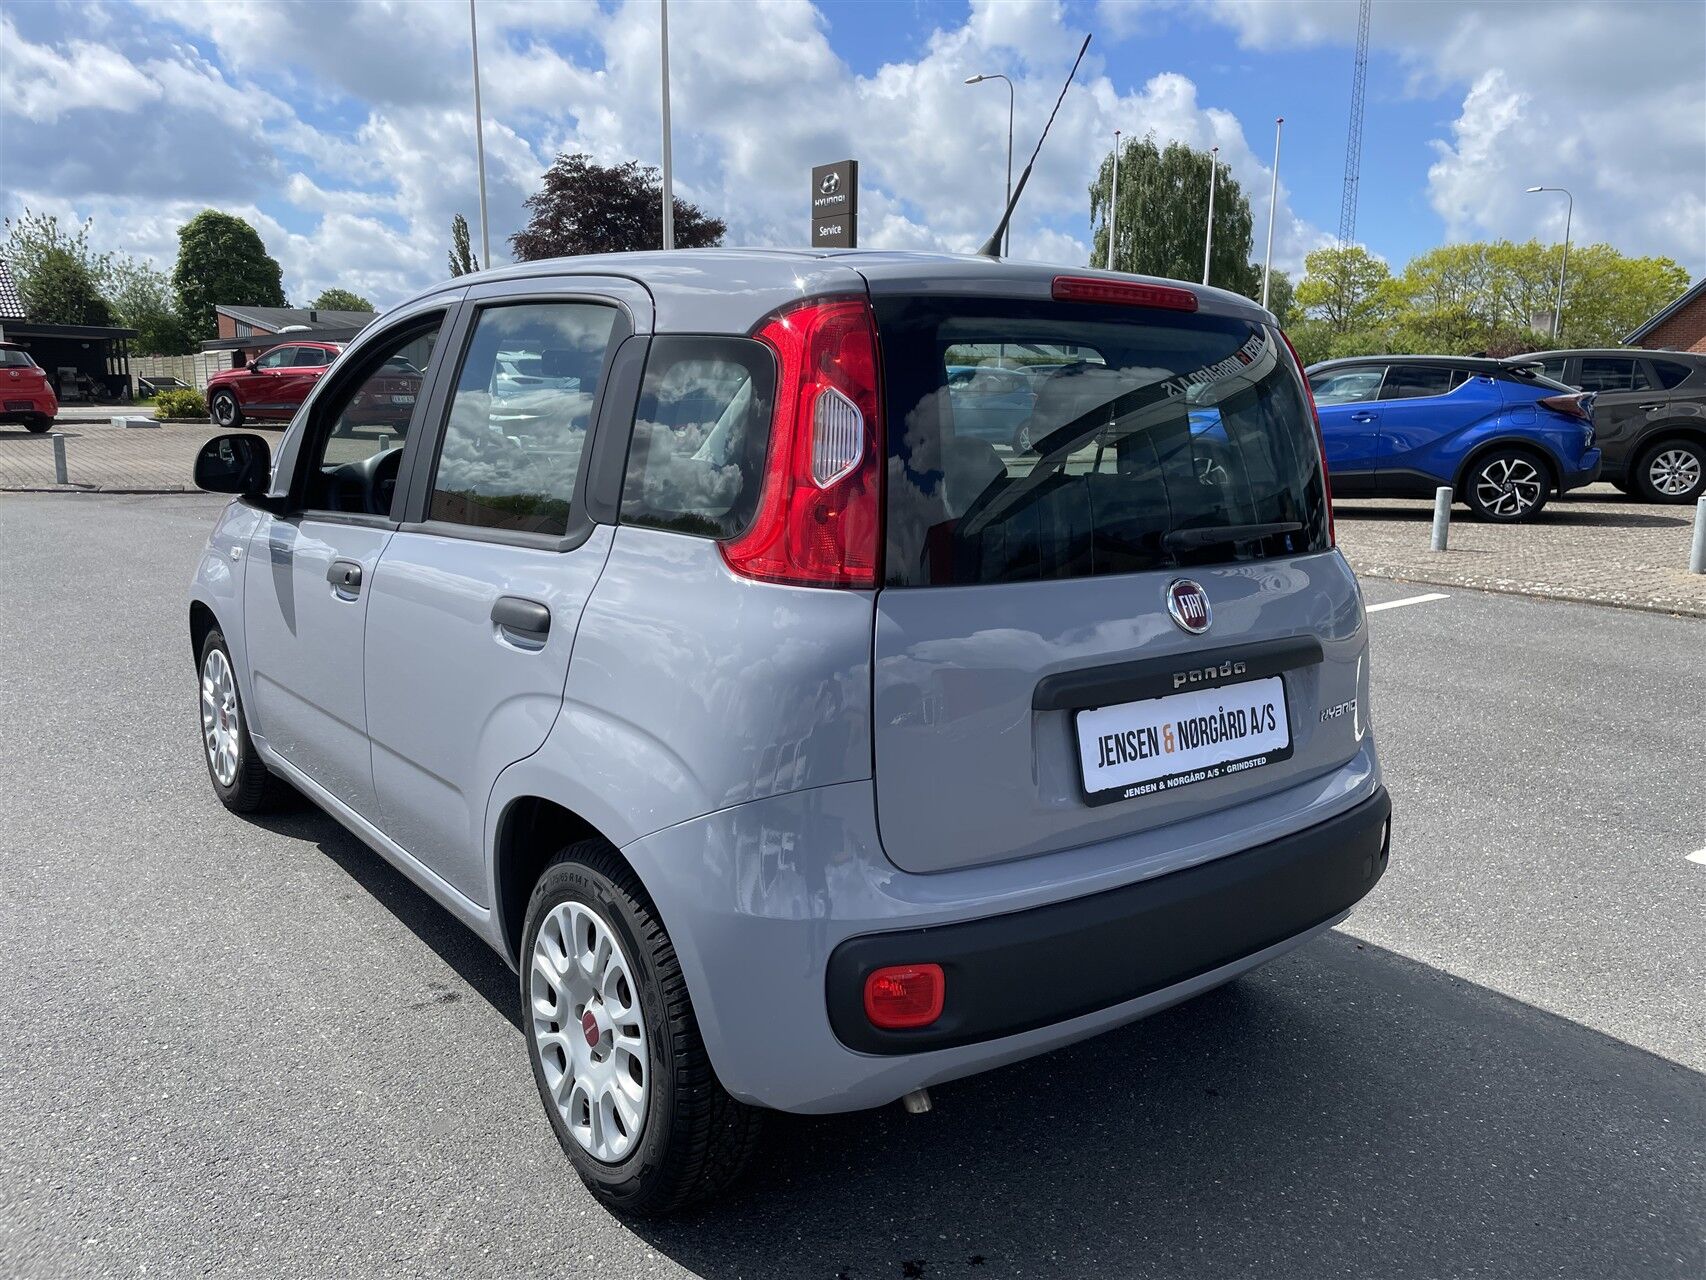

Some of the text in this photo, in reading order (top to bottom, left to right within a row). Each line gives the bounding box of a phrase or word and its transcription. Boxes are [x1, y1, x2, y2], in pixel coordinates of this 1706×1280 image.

[819, 224, 842, 237] Service
[1178, 593, 1205, 619] FIAT
[1173, 660, 1248, 689] panda
[1098, 702, 1277, 768] JENSEN & NØRGÅRD A/S
[1123, 756, 1267, 799] JENSEN & NØRGÅRD A/S GRINDSTED
